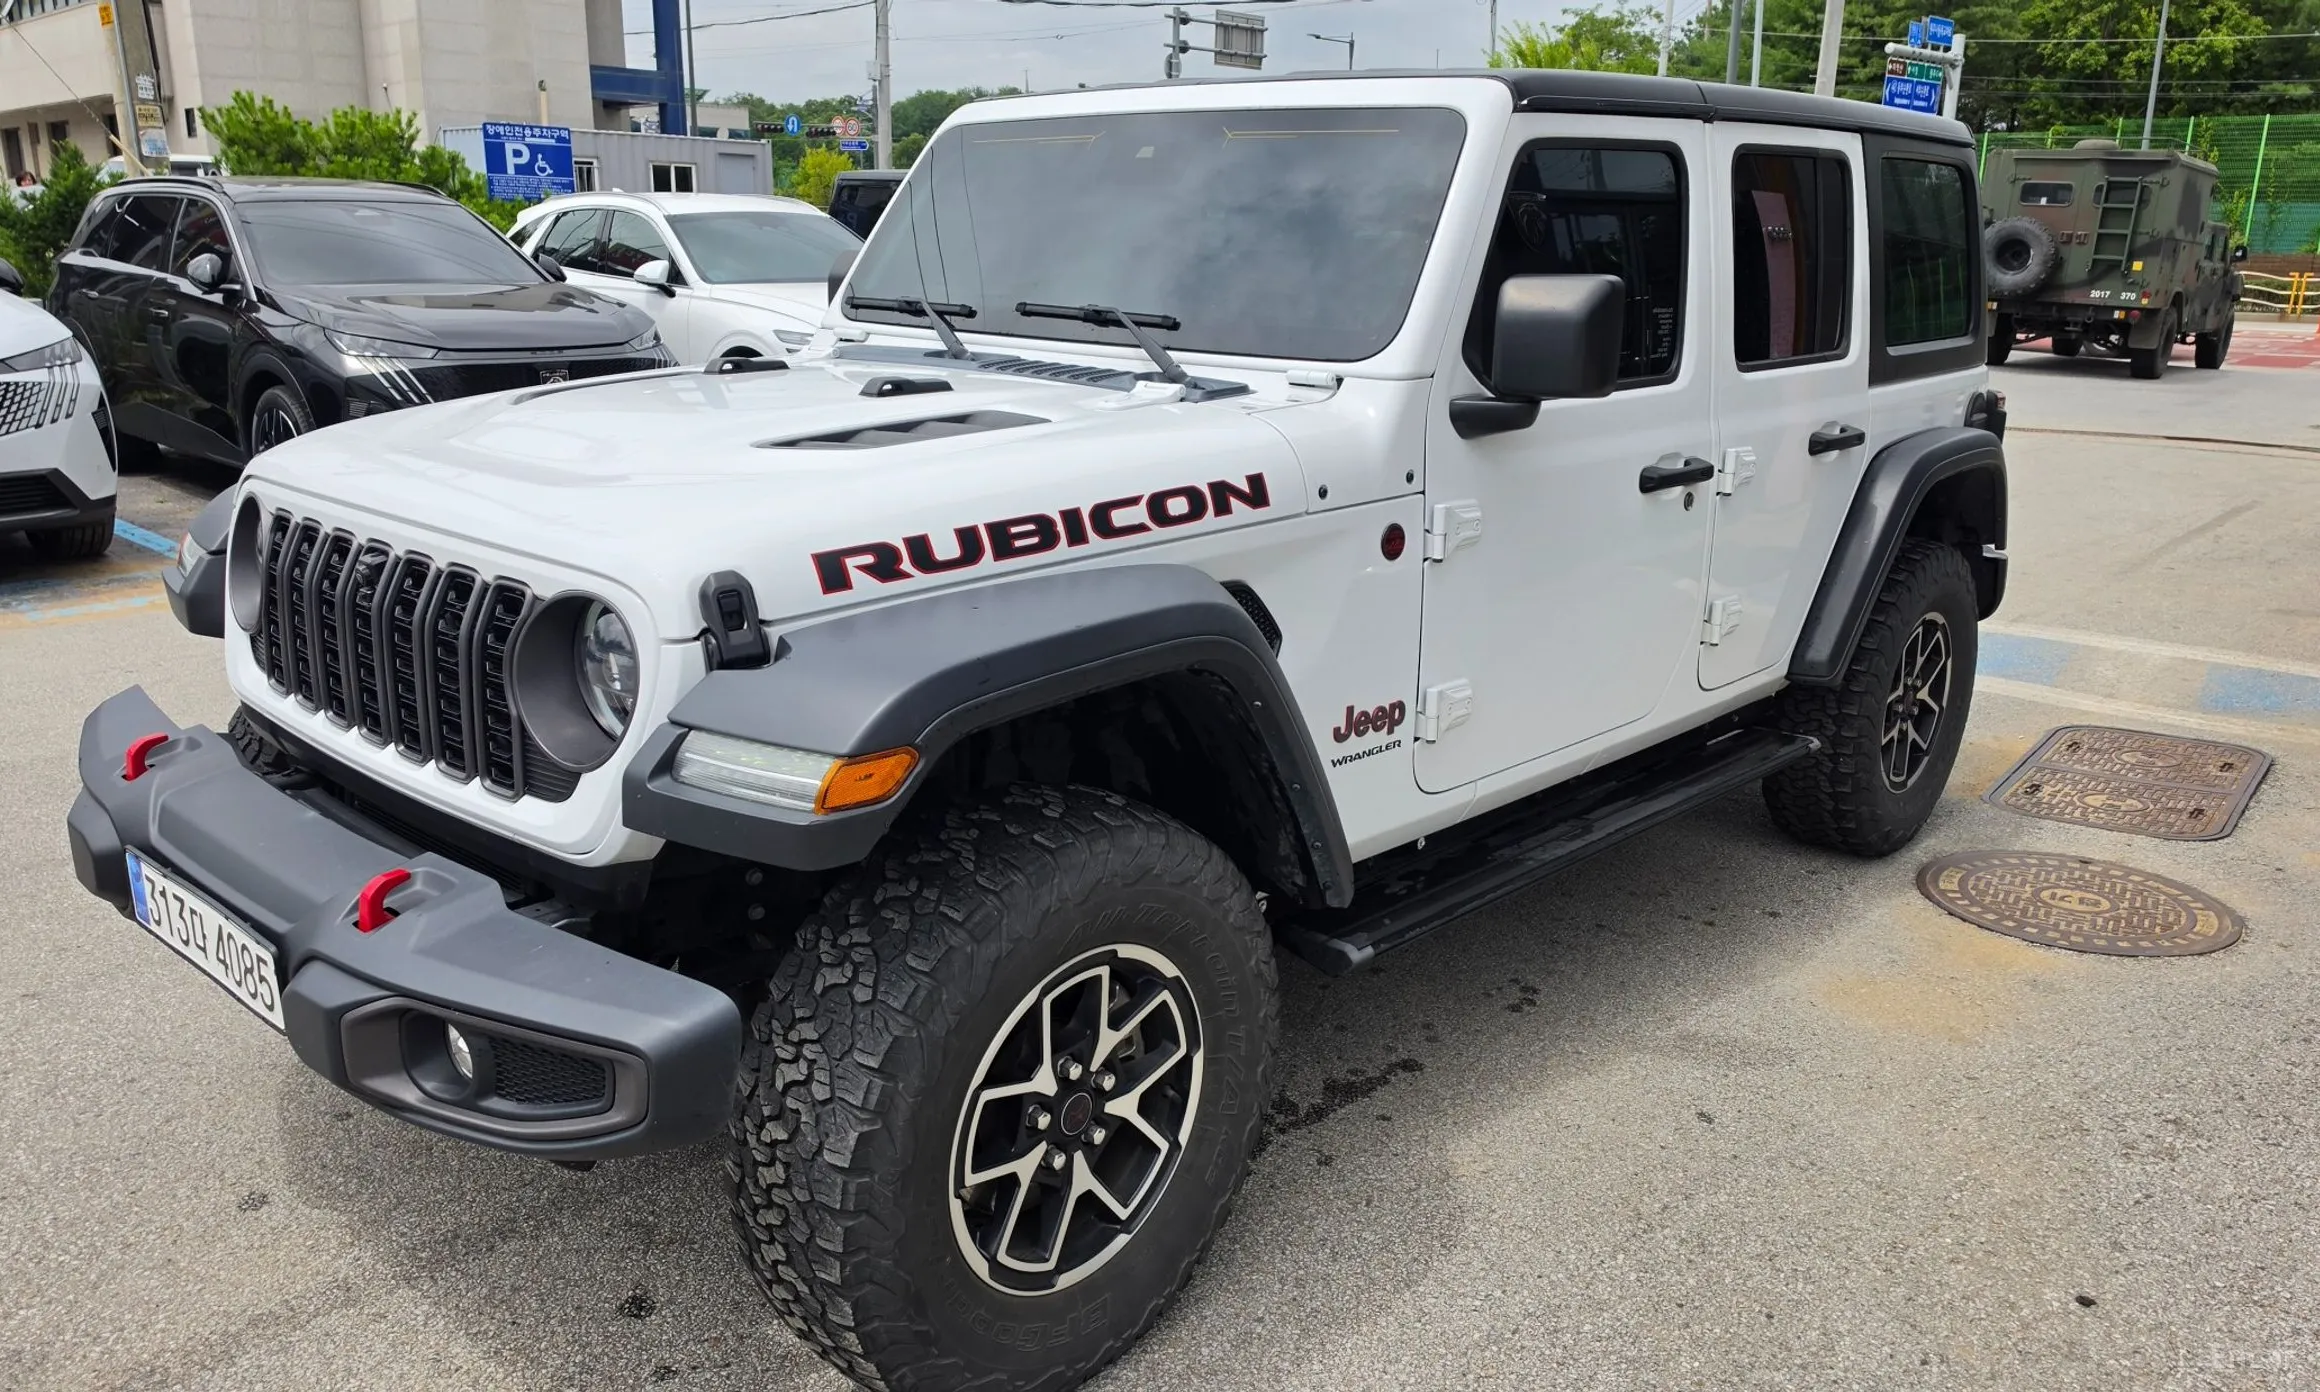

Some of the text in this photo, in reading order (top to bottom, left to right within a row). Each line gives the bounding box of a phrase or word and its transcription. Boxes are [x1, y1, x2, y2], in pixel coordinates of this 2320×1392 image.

[486, 124, 569, 140] 장애인전용주차구역
[504, 143, 530, 175] P
[2089, 290, 2136, 300] 2017 370
[811, 472, 1270, 594] RUBICON
[1333, 700, 1406, 743] Jeep
[1331, 740, 1402, 768] WRANGLER
[144, 874, 275, 1012] 313다 4085
